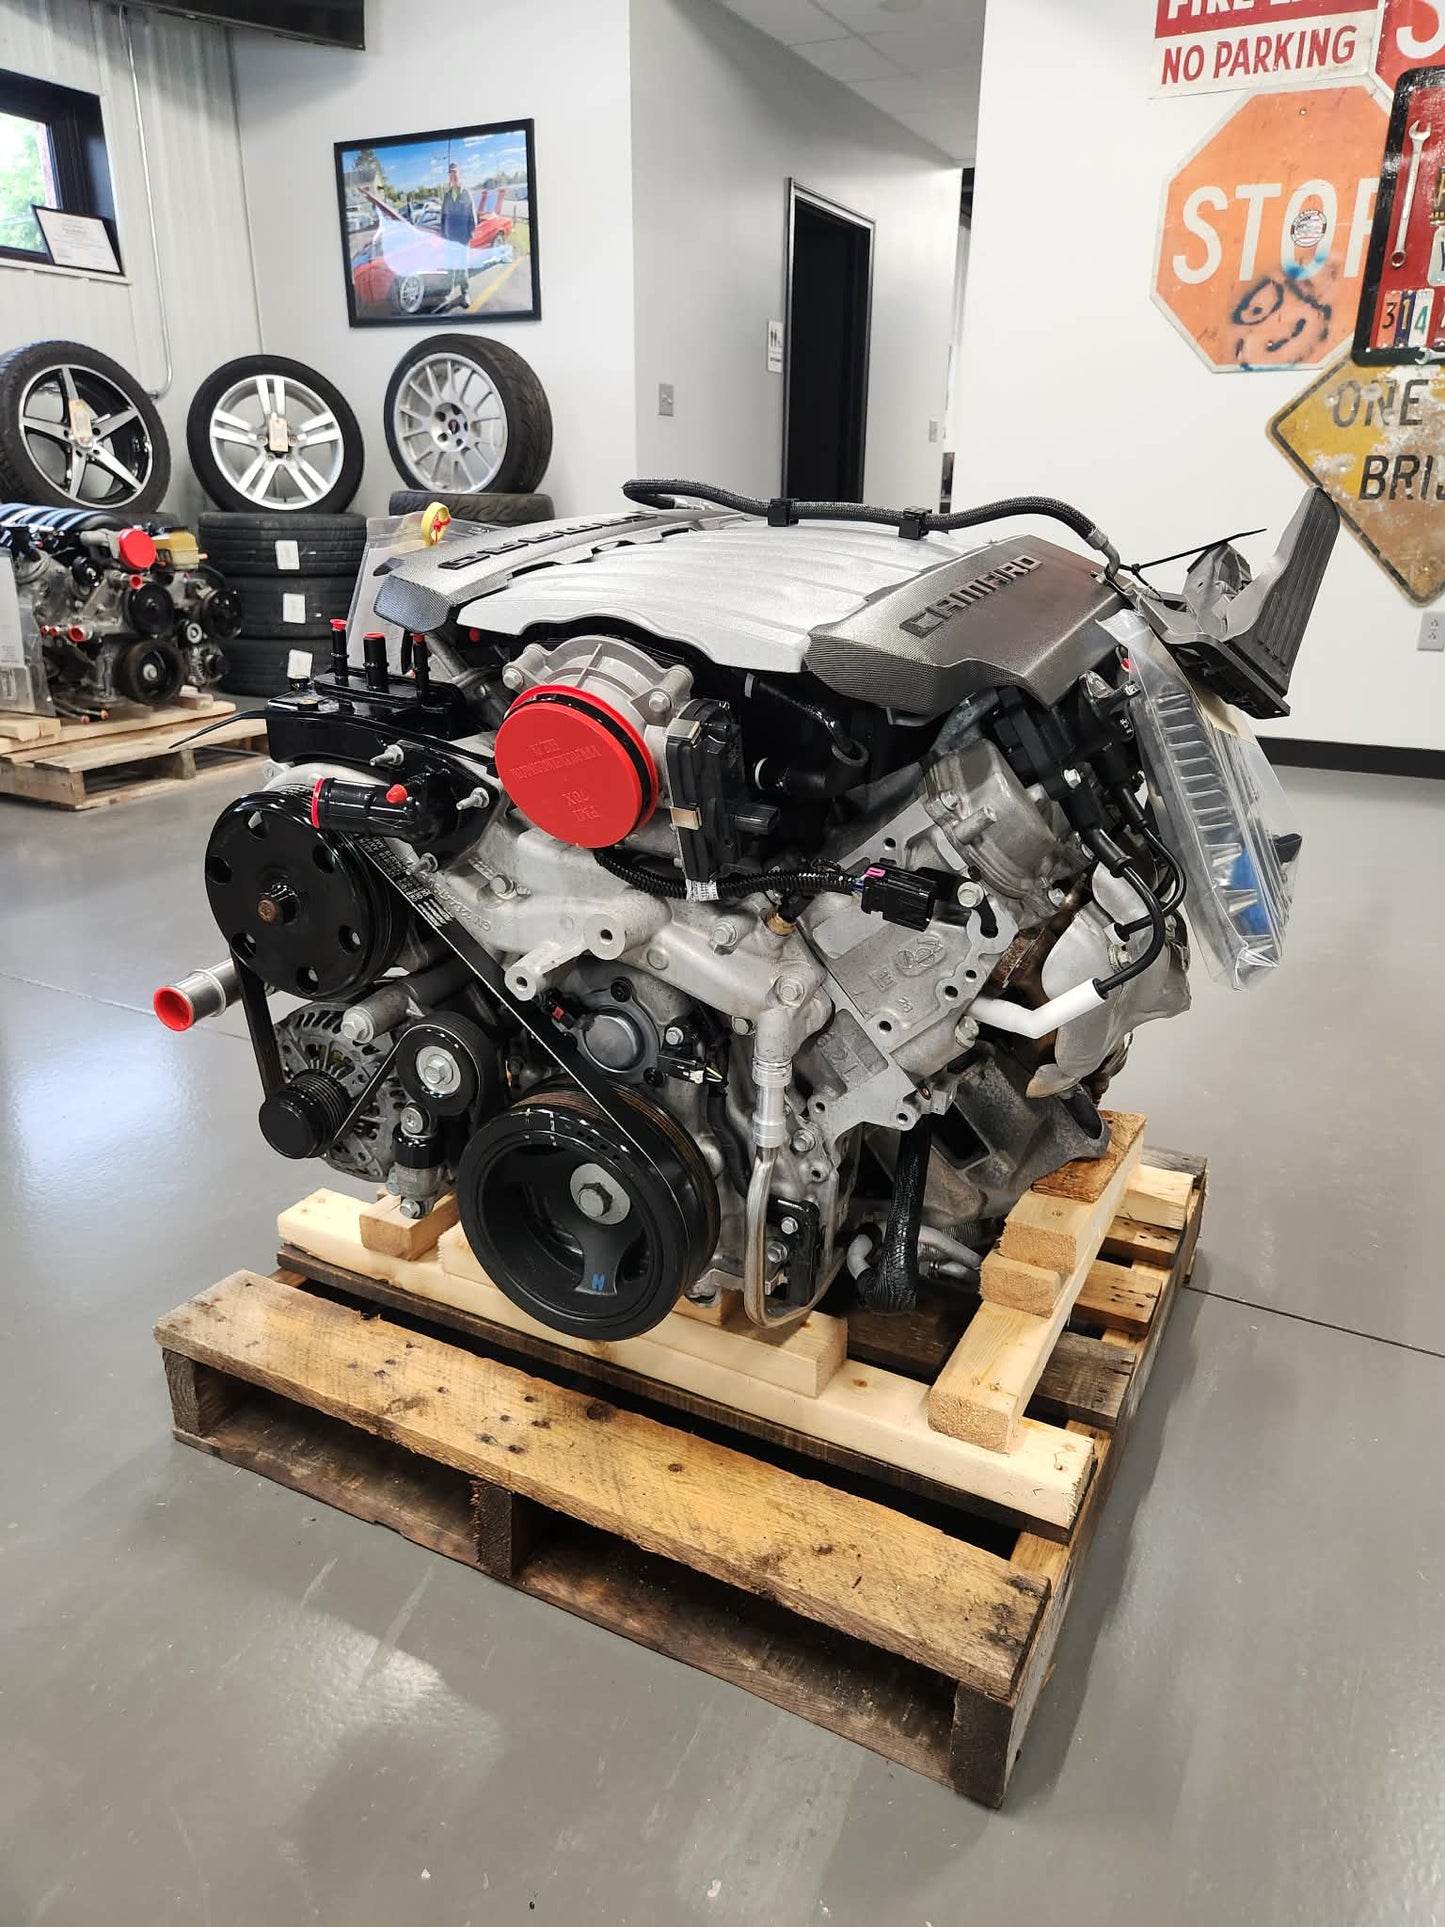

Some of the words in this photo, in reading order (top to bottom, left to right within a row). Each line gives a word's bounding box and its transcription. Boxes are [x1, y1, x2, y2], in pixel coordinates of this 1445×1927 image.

[1167, 0, 1255, 19] FI
[1161, 45, 1205, 85] NO
[1213, 25, 1357, 79] PARKING
[1333, 379, 1429, 428] ONE
[1359, 454, 1445, 500] BRI
[899, 554, 1043, 639] CAMARO
